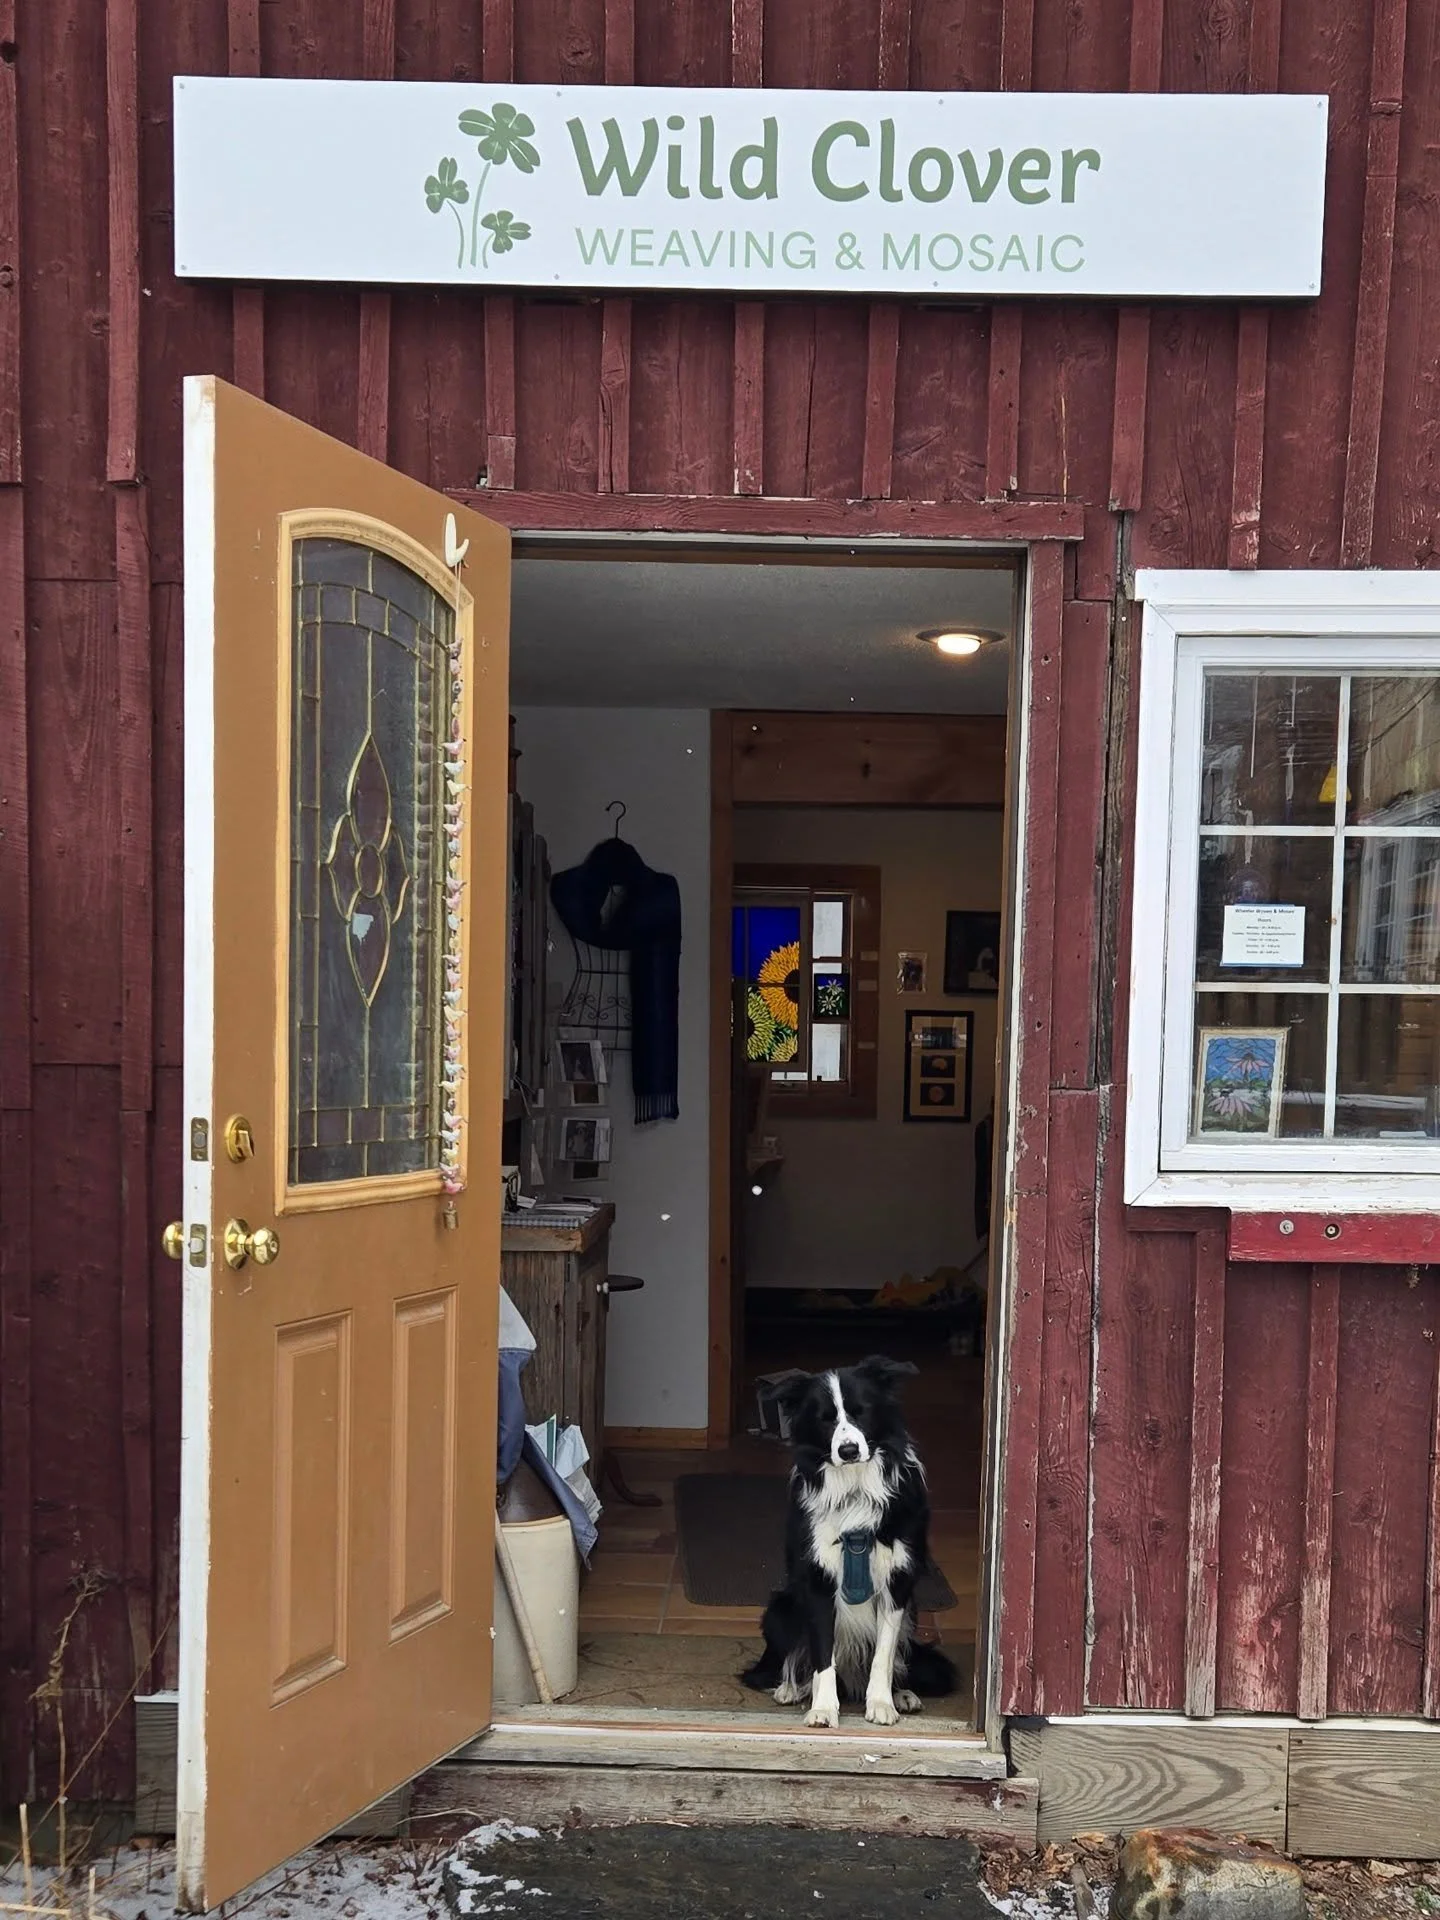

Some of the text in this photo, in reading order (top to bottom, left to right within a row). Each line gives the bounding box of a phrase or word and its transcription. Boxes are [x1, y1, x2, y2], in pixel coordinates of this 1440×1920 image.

[566, 115, 1101, 205] Wild Clover
[575, 227, 1086, 272] WEAVING & MOSAIC
